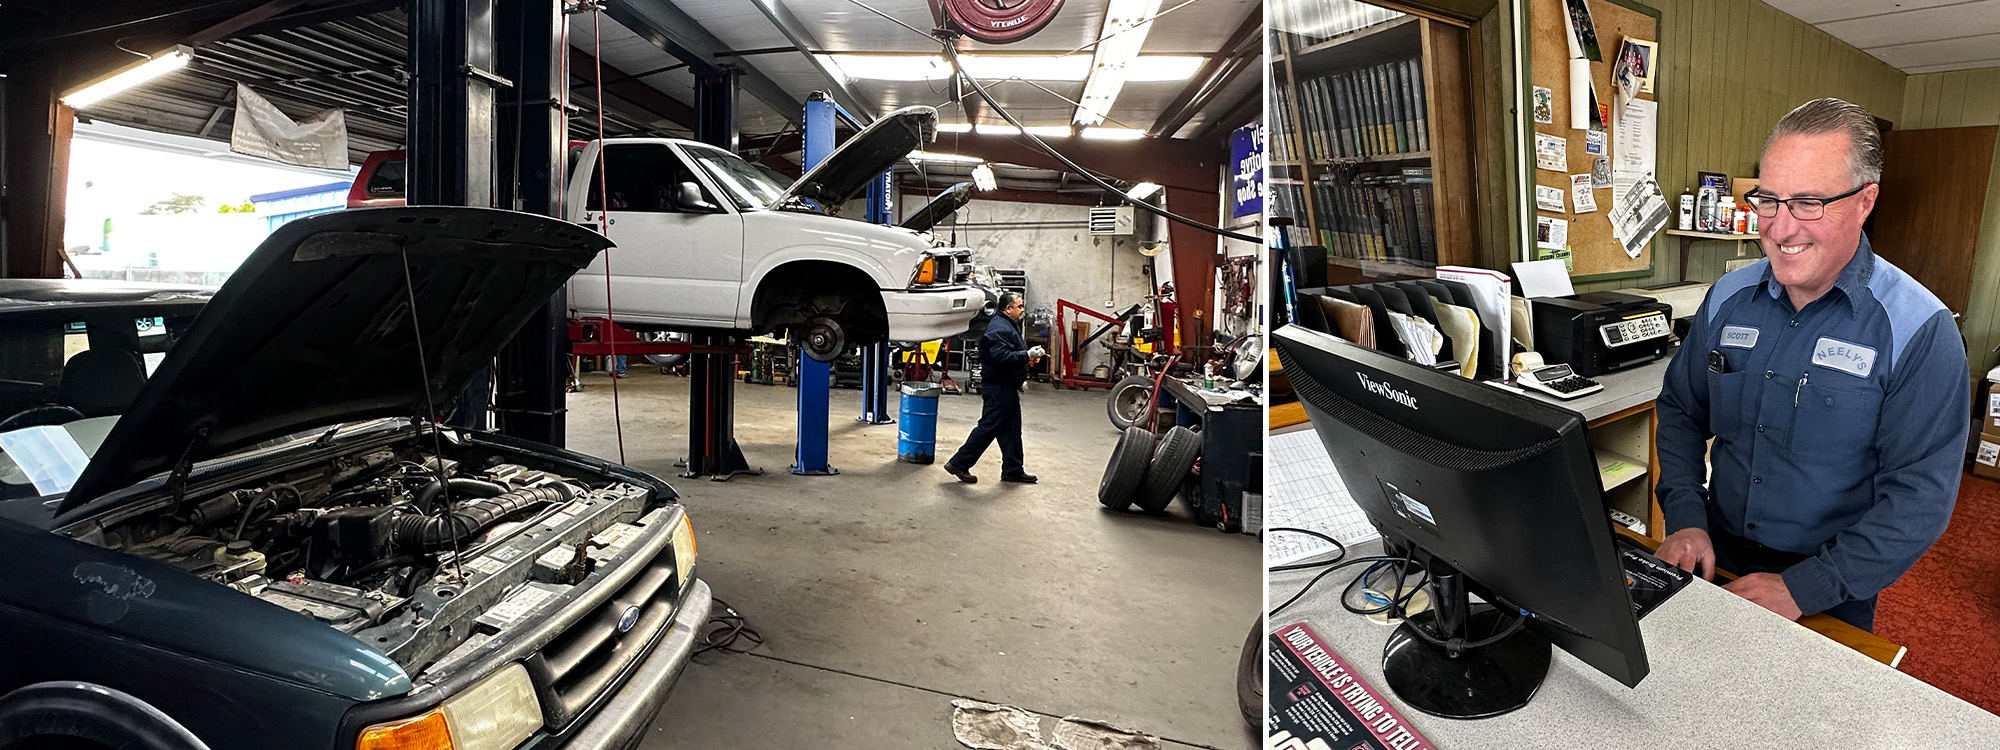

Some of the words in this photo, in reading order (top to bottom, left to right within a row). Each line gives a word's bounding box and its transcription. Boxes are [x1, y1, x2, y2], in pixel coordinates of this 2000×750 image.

[1726, 332, 1750, 341] SCOTT
[1817, 347, 1868, 371] NEELY'S
[1355, 371, 1419, 410] ViewSonic
[1656, 566, 1684, 580] Premium
[1284, 626, 1314, 651] YOUR
[1302, 644, 1344, 680] VEHICLE
[1330, 672, 1351, 689] IS
[1340, 681, 1384, 721] TRYING
[1371, 712, 1398, 733] TO
